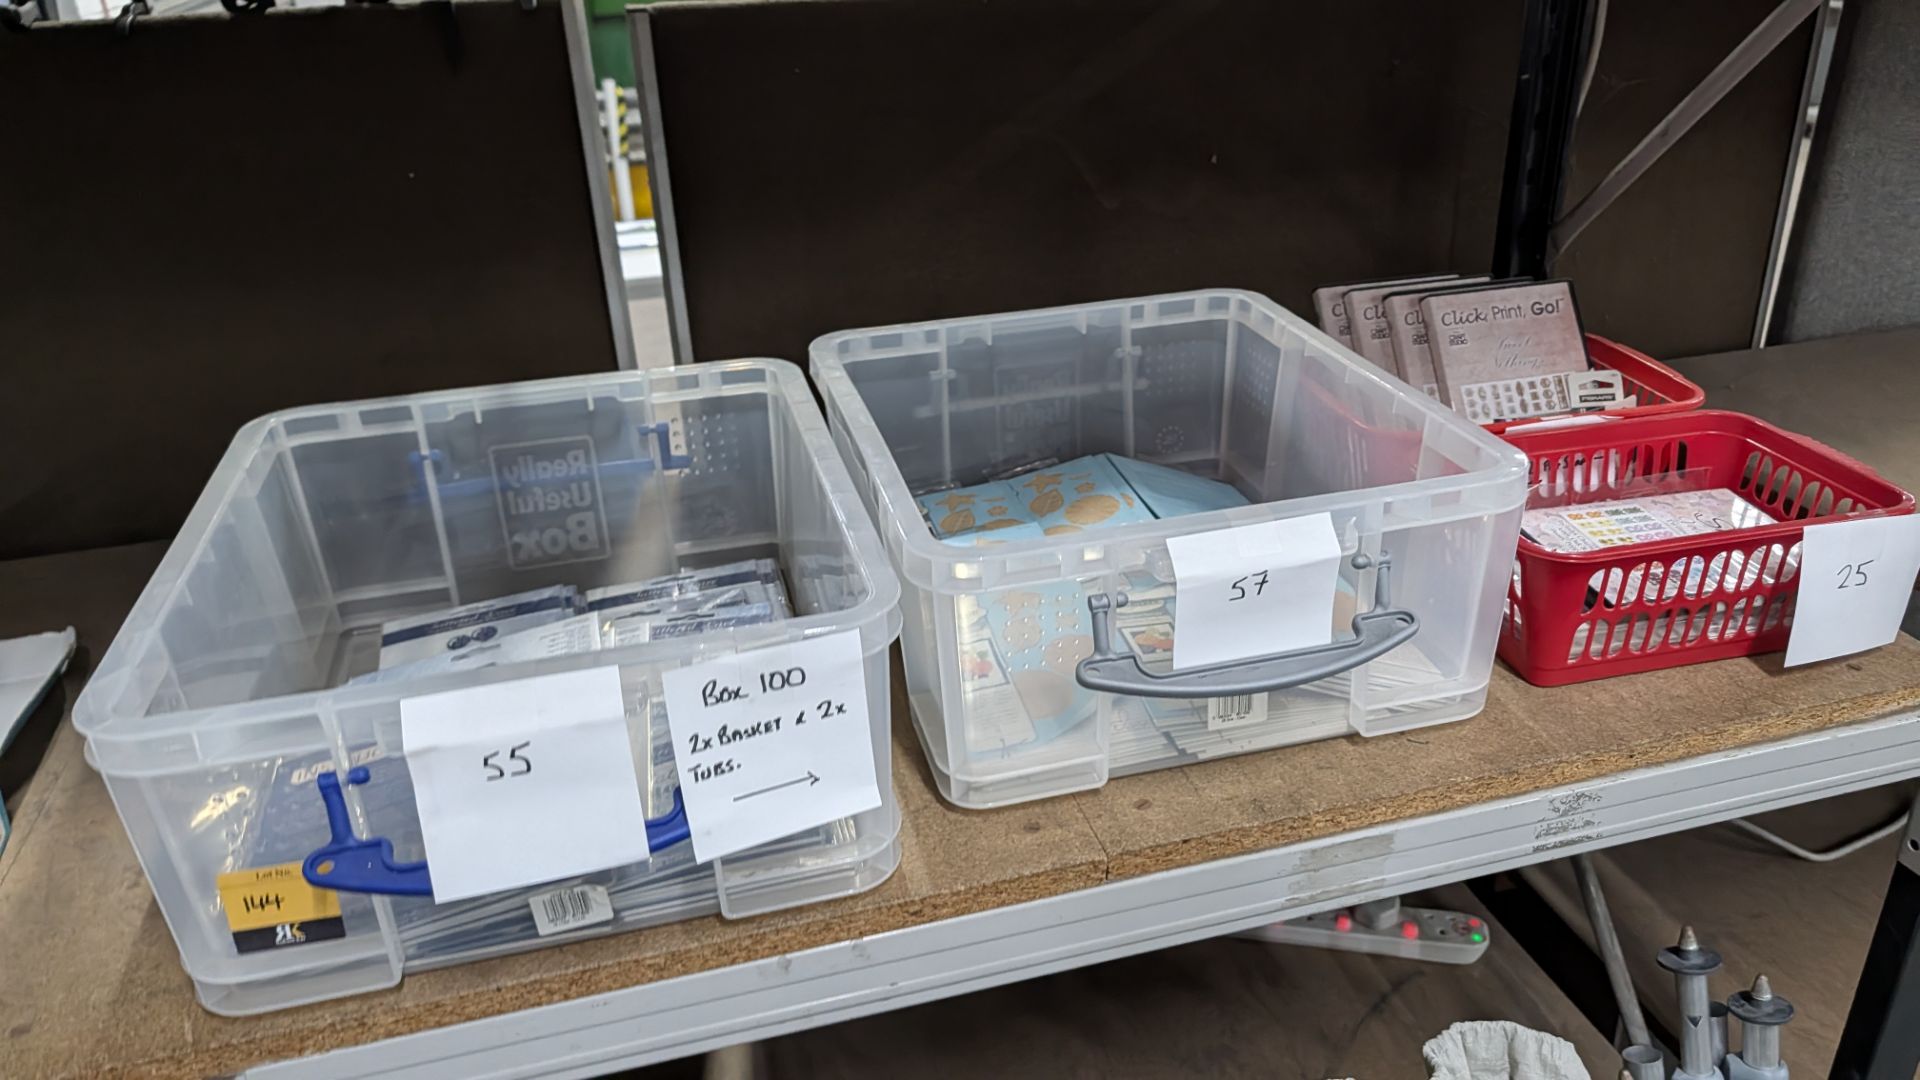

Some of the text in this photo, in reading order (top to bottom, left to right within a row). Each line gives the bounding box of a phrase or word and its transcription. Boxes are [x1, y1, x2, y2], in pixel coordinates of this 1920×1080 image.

[1491, 304, 1526, 320] Print,
[1229, 569, 1269, 602] 57
[1837, 559, 1875, 589] 25
[759, 667, 806, 693] 100
[688, 733, 713, 754] 2x
[717, 717, 782, 746] BASKET
[816, 700, 847, 720] 2x
[483, 740, 532, 782] 55
[242, 892, 285, 913] 144
